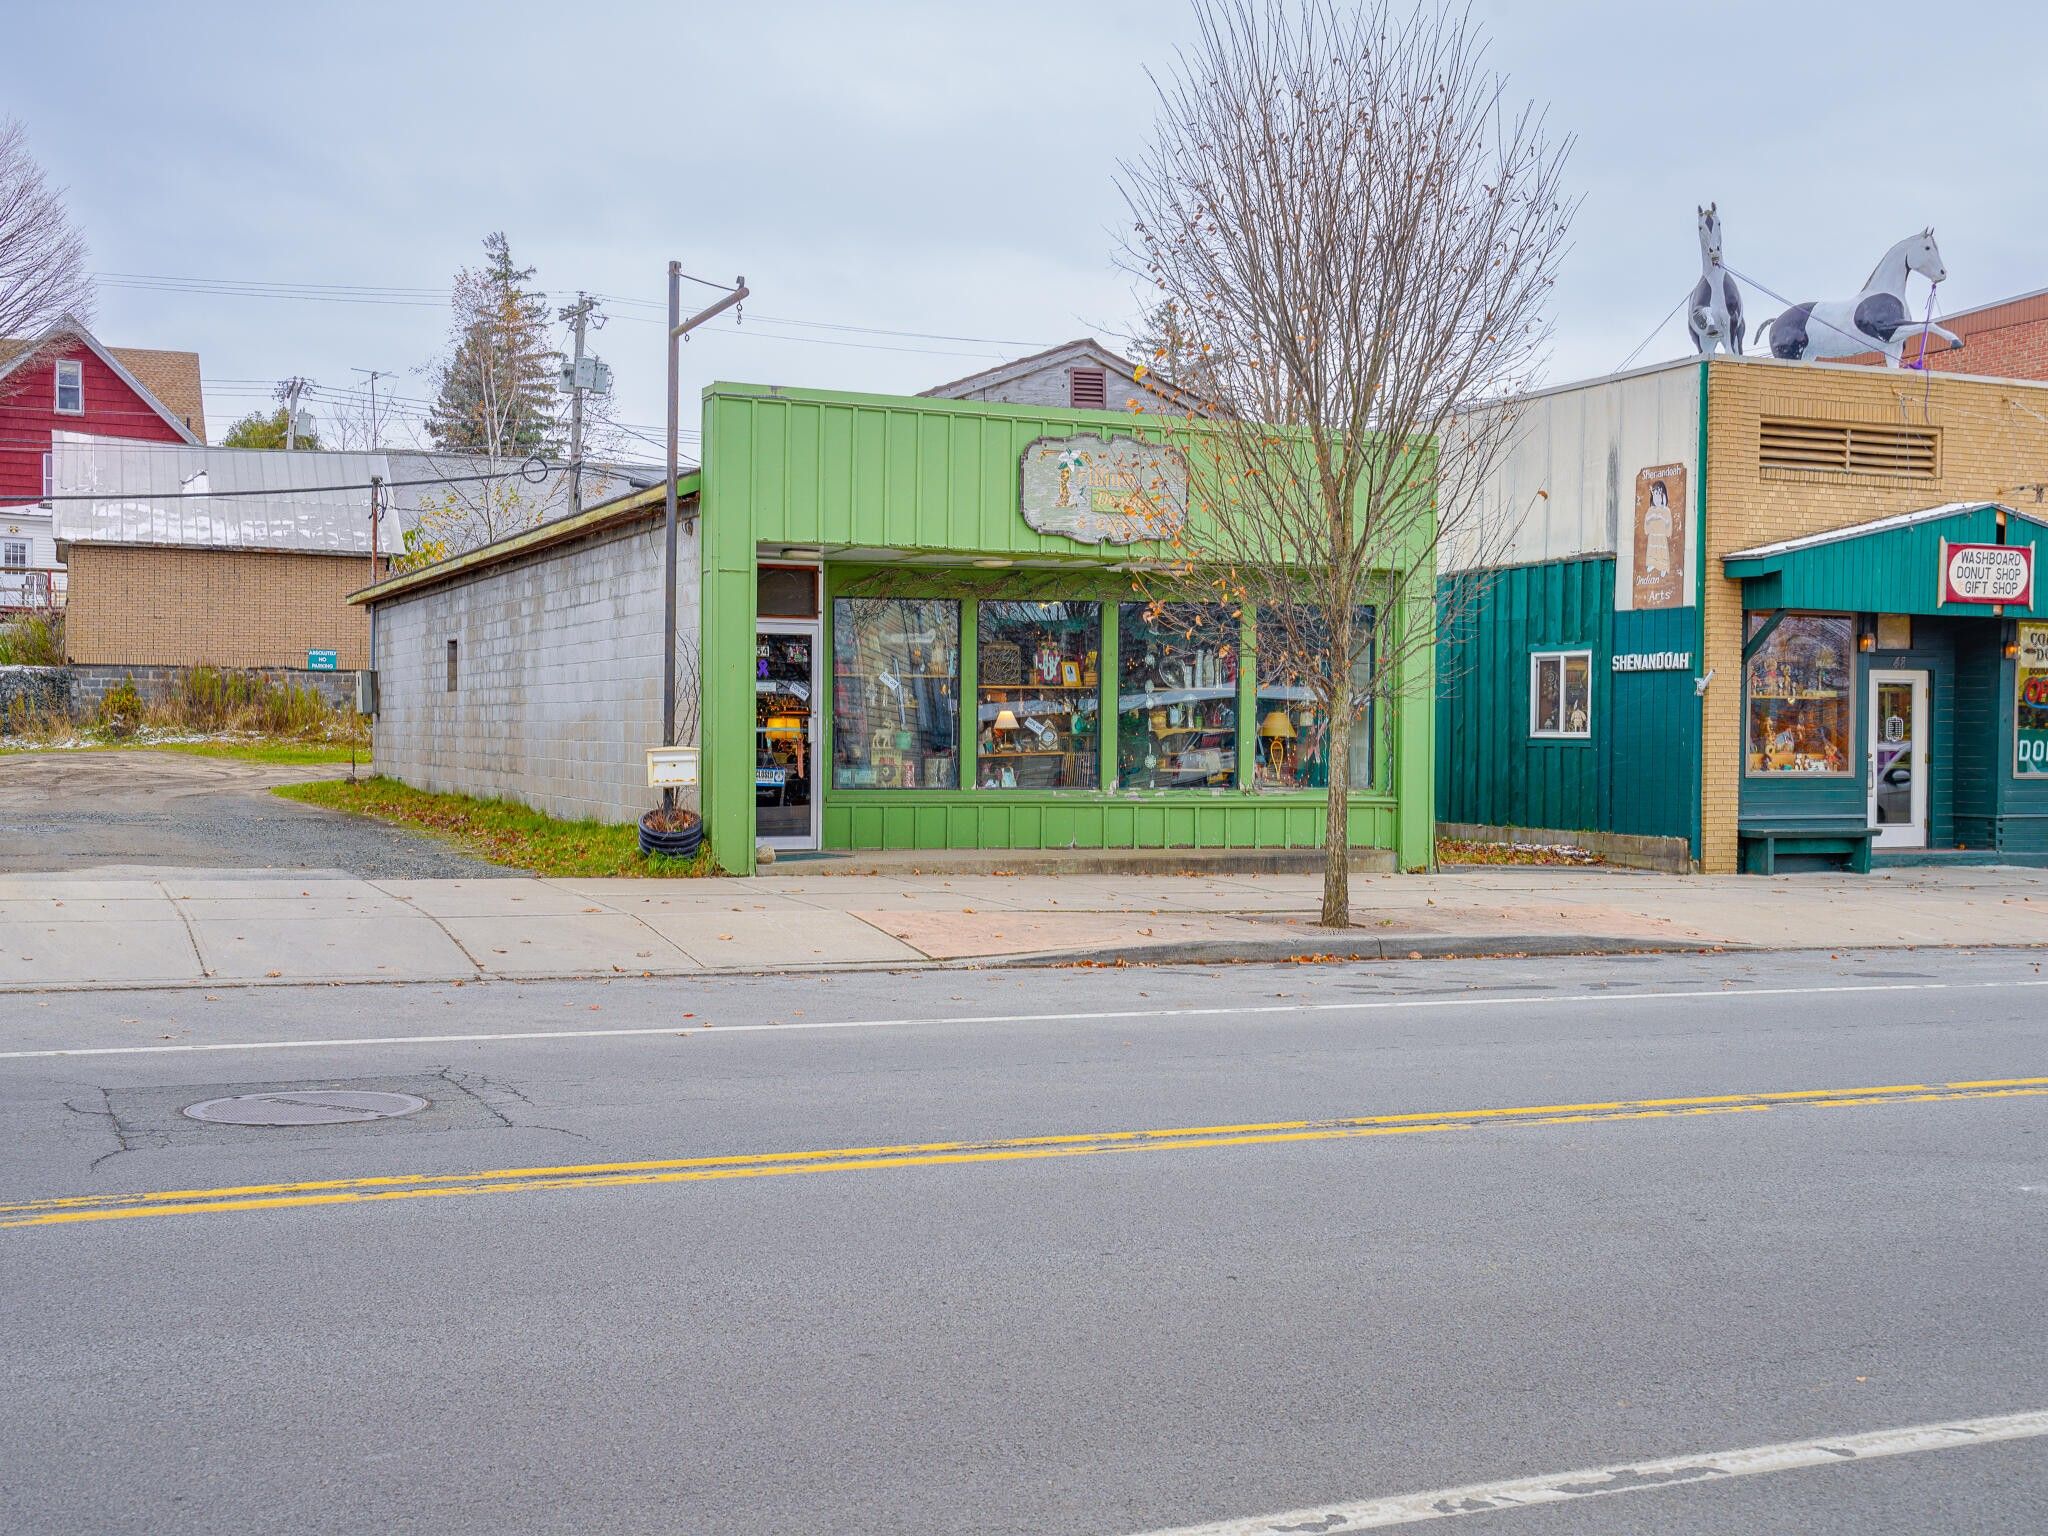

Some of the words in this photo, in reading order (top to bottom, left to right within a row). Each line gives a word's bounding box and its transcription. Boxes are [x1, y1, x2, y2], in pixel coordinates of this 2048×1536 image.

[1642, 465, 1681, 480] Shenandoah
[1961, 551, 2021, 566] WASHBOARD
[1956, 566, 1991, 580] DONUT
[1995, 568, 2021, 581] SHOP
[1965, 581, 1988, 594] GIFT
[1992, 582, 2018, 595] SHOP
[2030, 632, 2048, 647] CO
[1612, 652, 1689, 671] SHENANDOAH
[2018, 739, 2048, 762] DO
